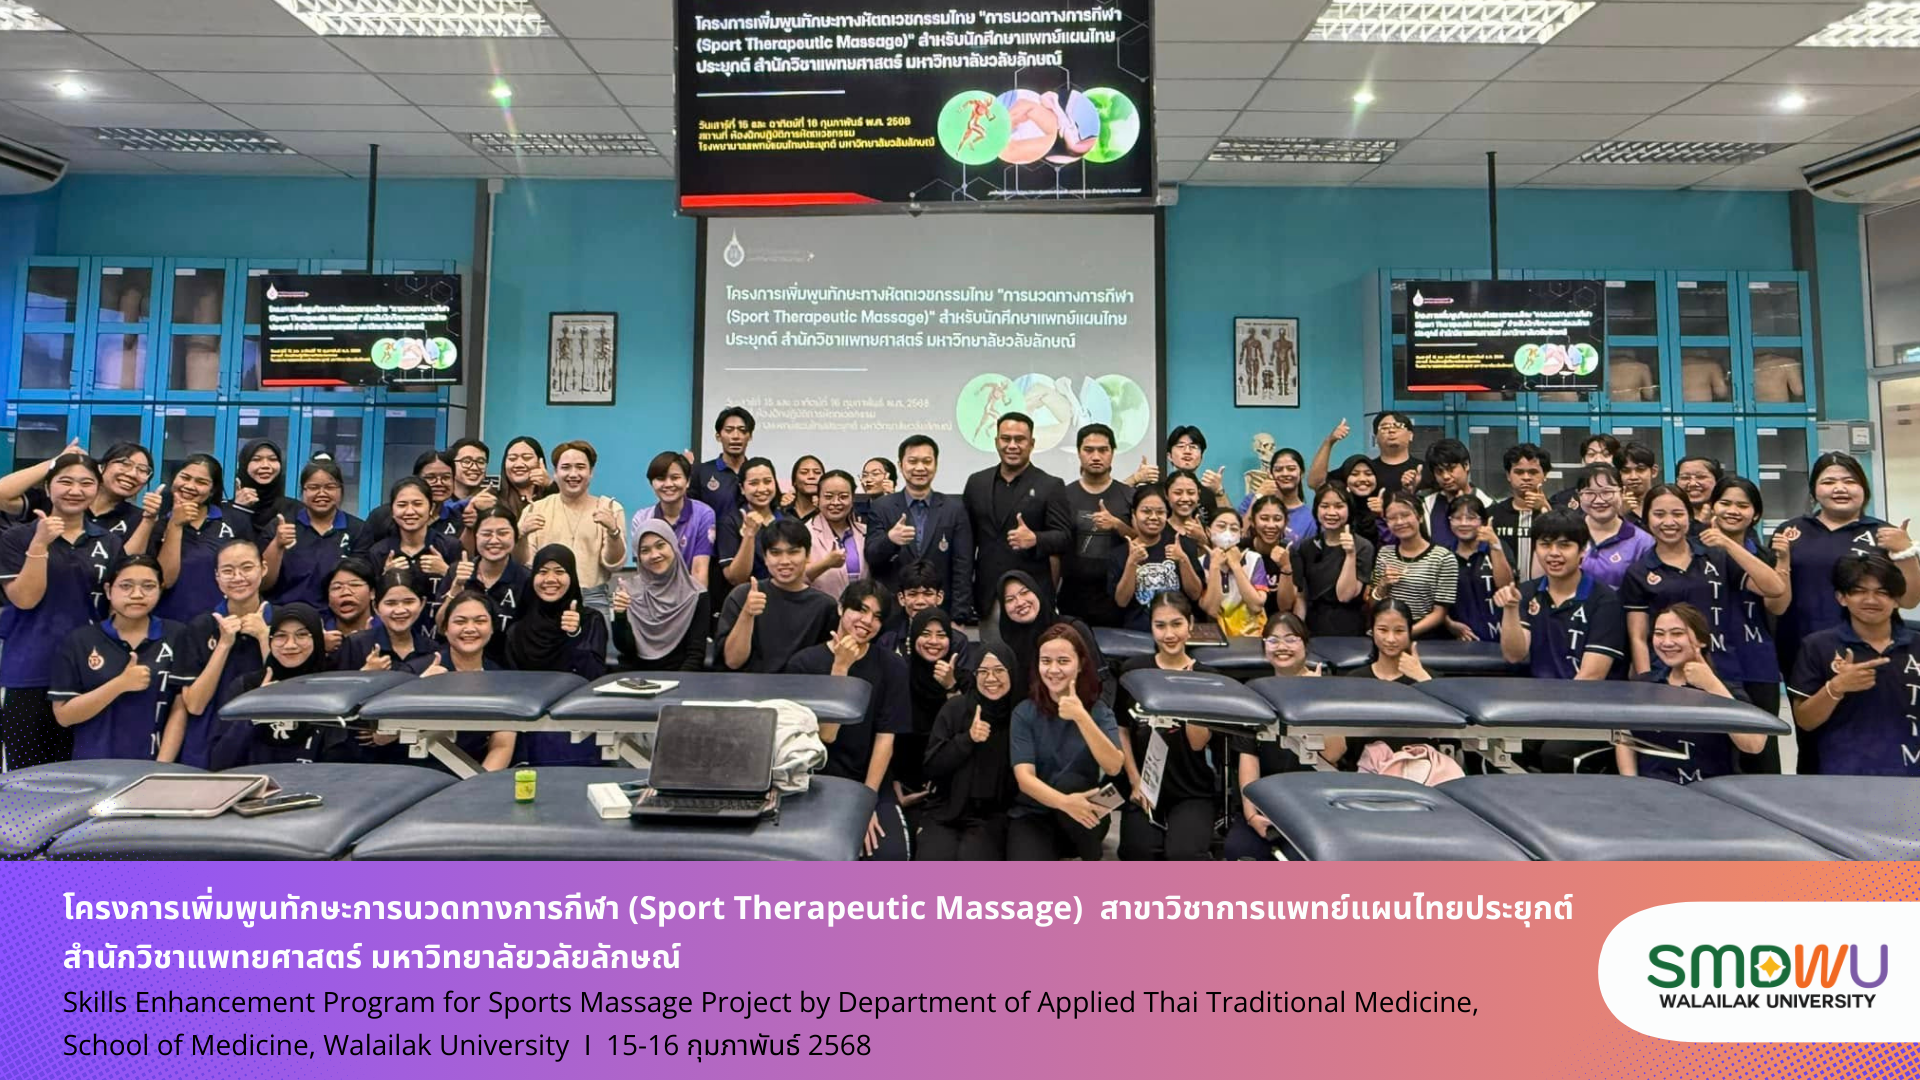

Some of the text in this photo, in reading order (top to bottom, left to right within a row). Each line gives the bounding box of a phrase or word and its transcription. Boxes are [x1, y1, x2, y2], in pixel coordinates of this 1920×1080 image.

[696, 38, 742, 54] (Sport
[726, 310, 770, 326] (Sport
[774, 309, 857, 326] Therapeutic
[861, 310, 936, 327] Massage)"
